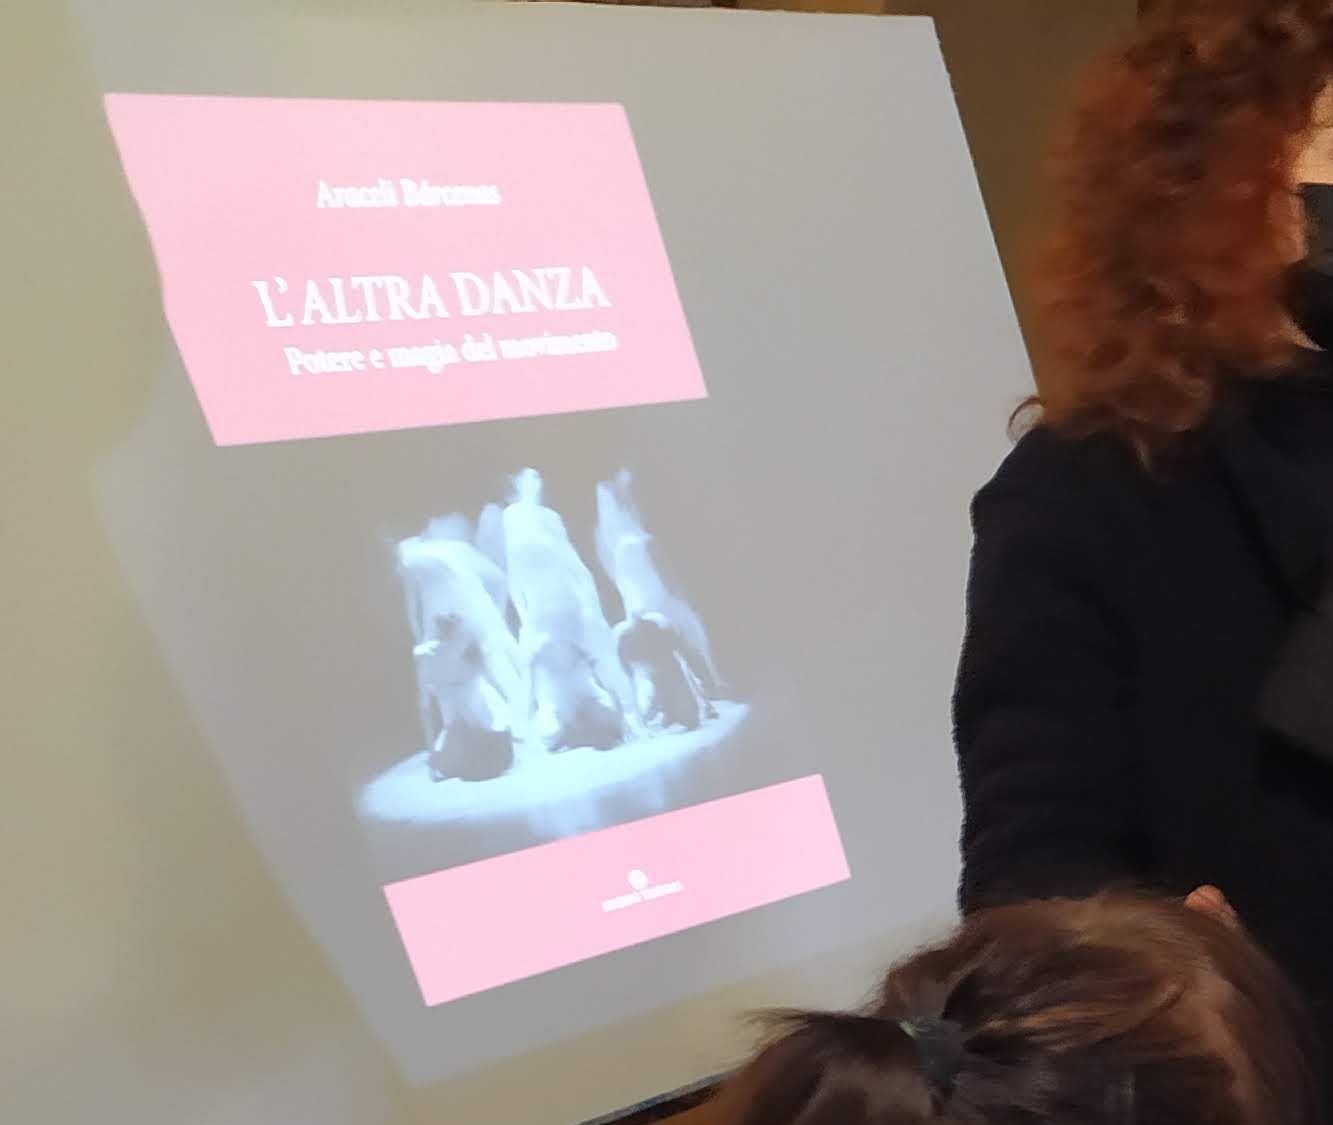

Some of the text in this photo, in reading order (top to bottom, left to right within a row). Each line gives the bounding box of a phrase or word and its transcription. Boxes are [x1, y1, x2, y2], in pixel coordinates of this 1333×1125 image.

[250, 265, 613, 327] L'ALTRA DANZA
[283, 346, 367, 375] Potere
[368, 348, 385, 369] e
